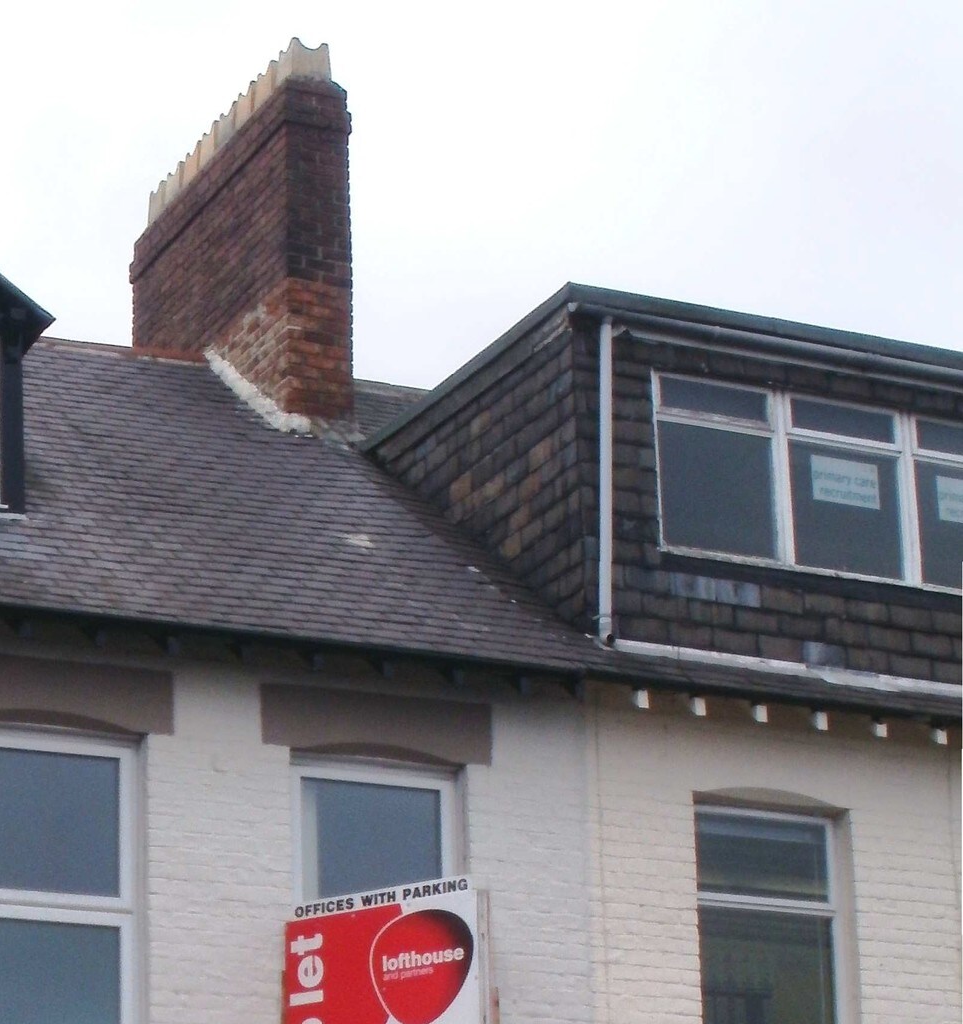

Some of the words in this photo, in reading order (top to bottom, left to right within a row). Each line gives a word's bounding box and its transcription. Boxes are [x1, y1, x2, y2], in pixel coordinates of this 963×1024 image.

[294, 897, 354, 918] OFFICES
[361, 891, 396, 907] WITH
[402, 878, 469, 900] PARKING
[289, 933, 324, 1007] let
[382, 947, 465, 972] lofthouse
[383, 972, 398, 981] and
[400, 967, 434, 980] partners
